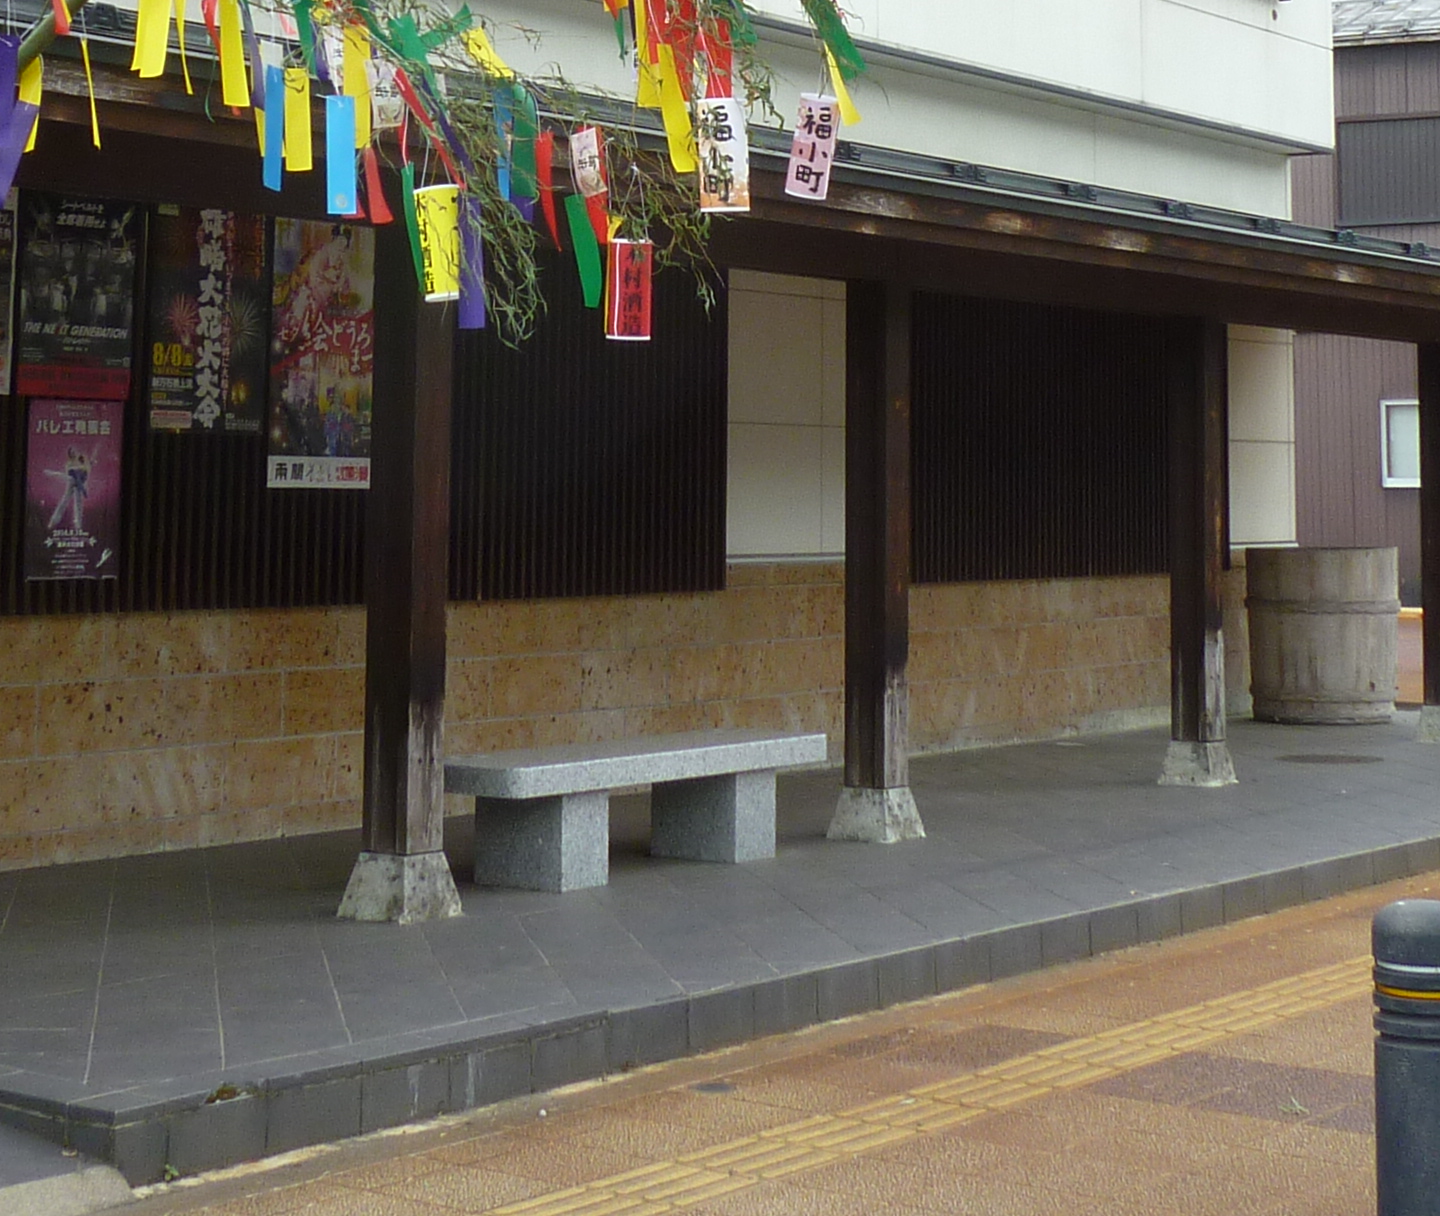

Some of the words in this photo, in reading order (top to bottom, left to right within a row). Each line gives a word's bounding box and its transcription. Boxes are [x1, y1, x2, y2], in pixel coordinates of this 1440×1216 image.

[795, 106, 828, 194] 福小町
[23, 321, 43, 334] THE
[70, 325, 128, 340] GENERATION
